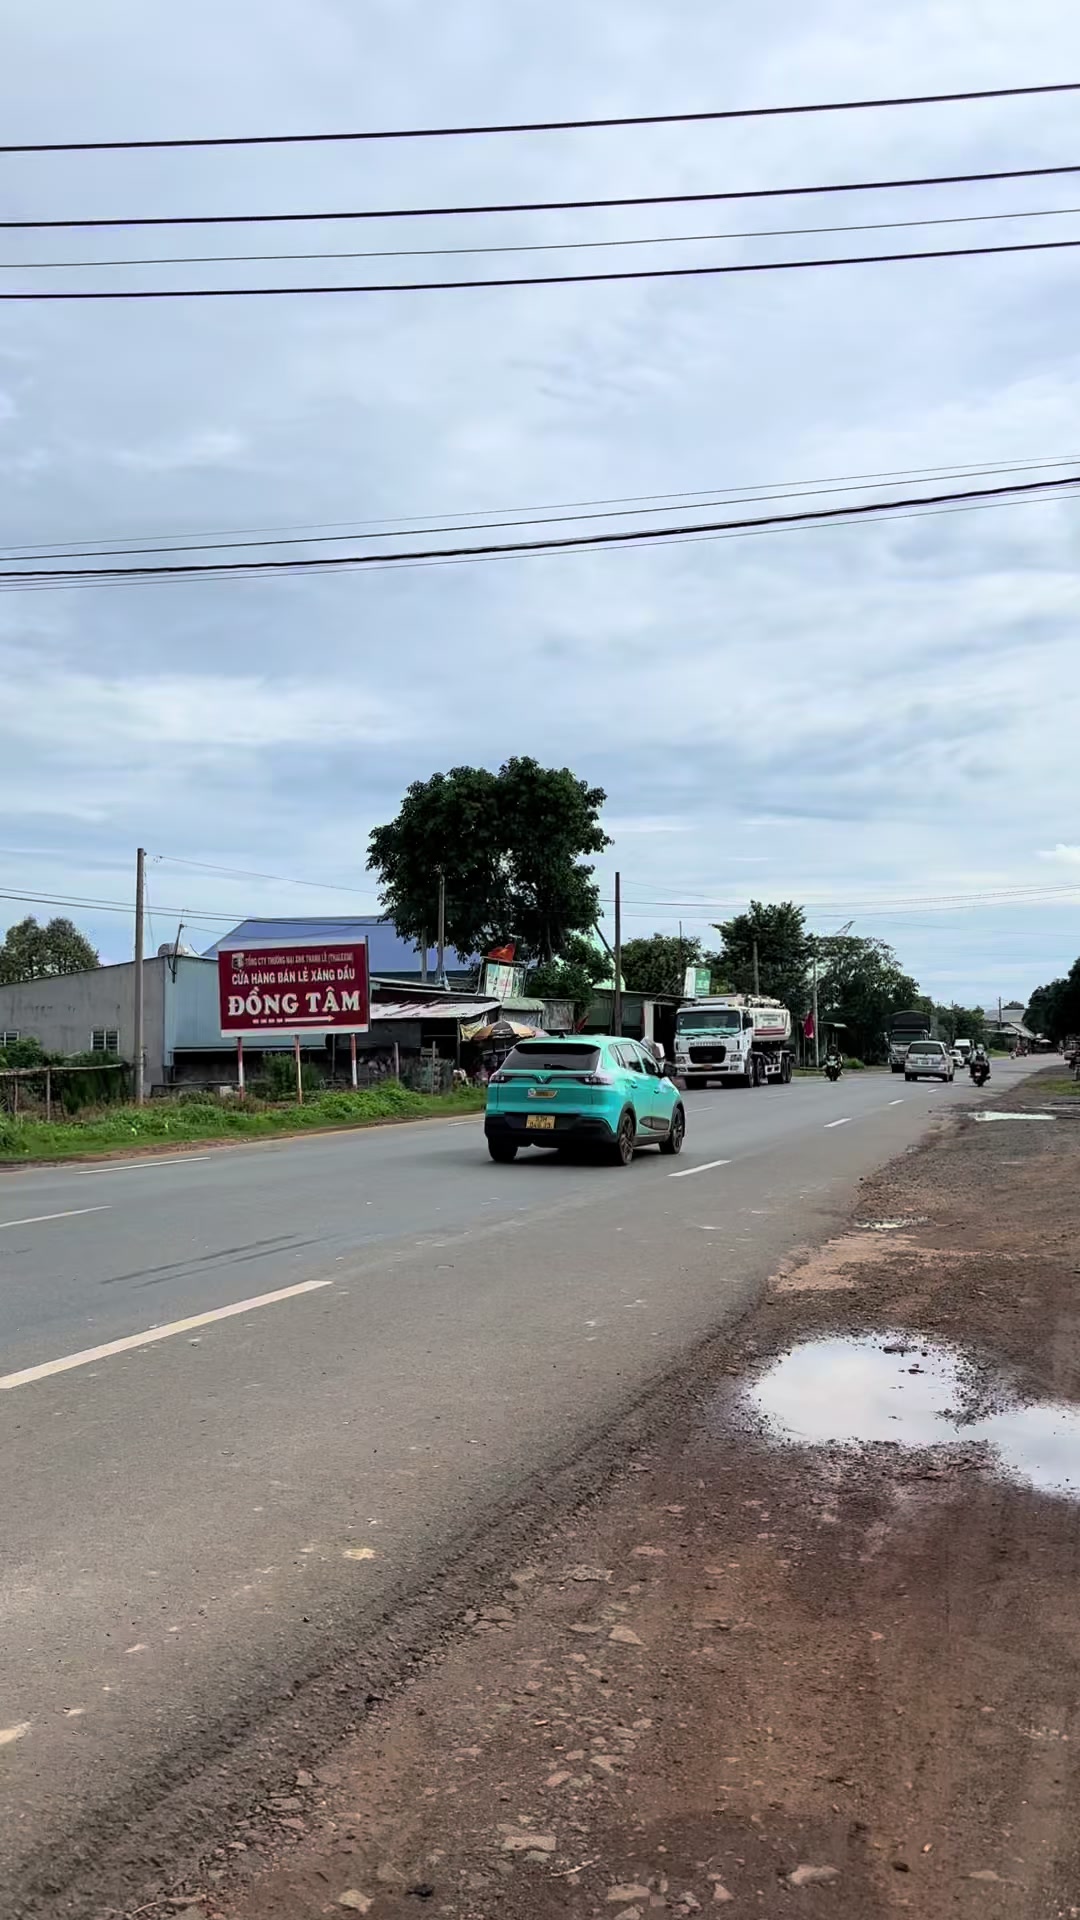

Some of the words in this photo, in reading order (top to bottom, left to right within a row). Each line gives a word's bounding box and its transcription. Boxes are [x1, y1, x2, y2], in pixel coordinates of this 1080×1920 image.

[232, 969, 249, 985] CỬA
[251, 970, 275, 984] HÀNG
[278, 968, 296, 983] BÁN
[298, 966, 309, 982] LẺ
[311, 967, 335, 982] XĂNG
[228, 986, 299, 1016] ĐỒNG
[305, 985, 361, 1013] TÂM
